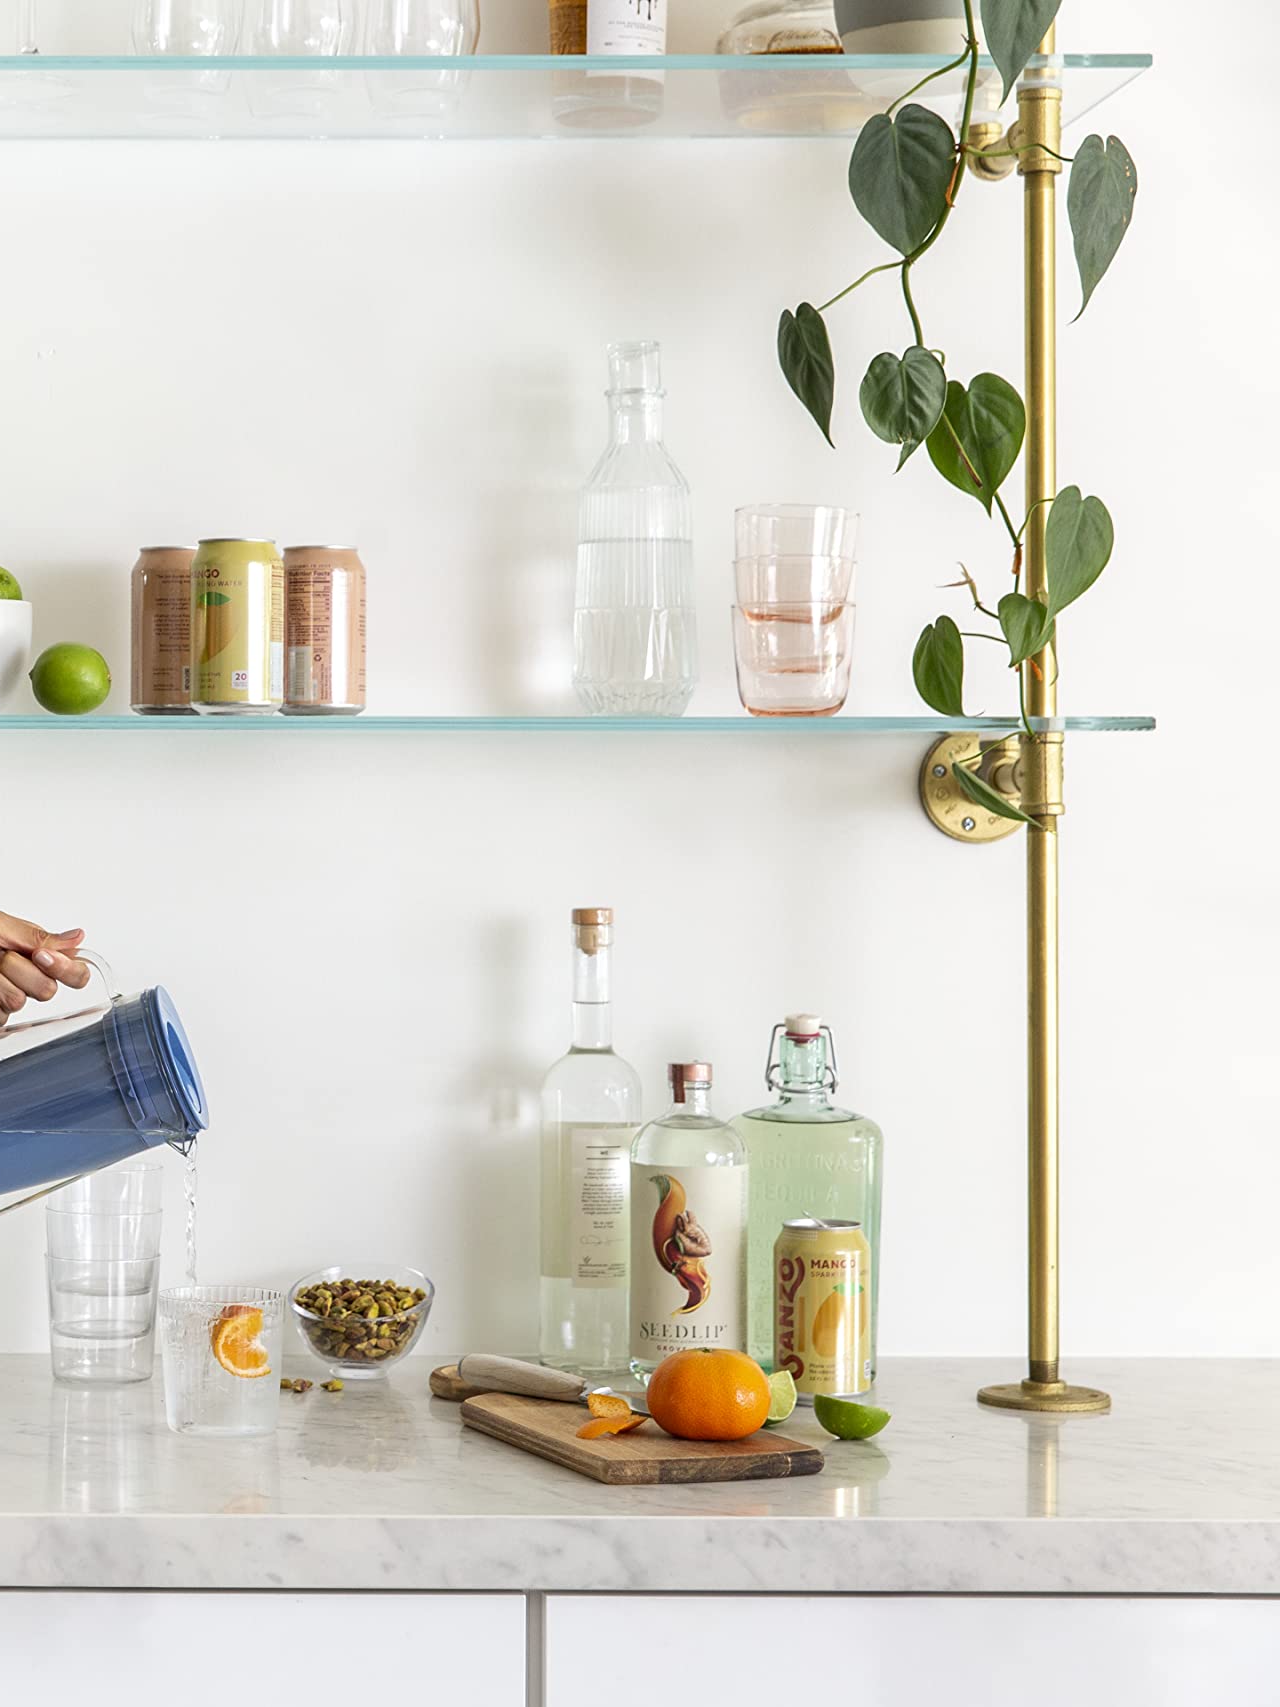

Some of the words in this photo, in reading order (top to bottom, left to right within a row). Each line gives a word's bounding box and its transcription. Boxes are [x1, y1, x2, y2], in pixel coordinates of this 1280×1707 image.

[235, 672, 247, 681] 20
[778, 1256, 806, 1380] SANZO
[639, 1321, 724, 1341] SEEDLIP
